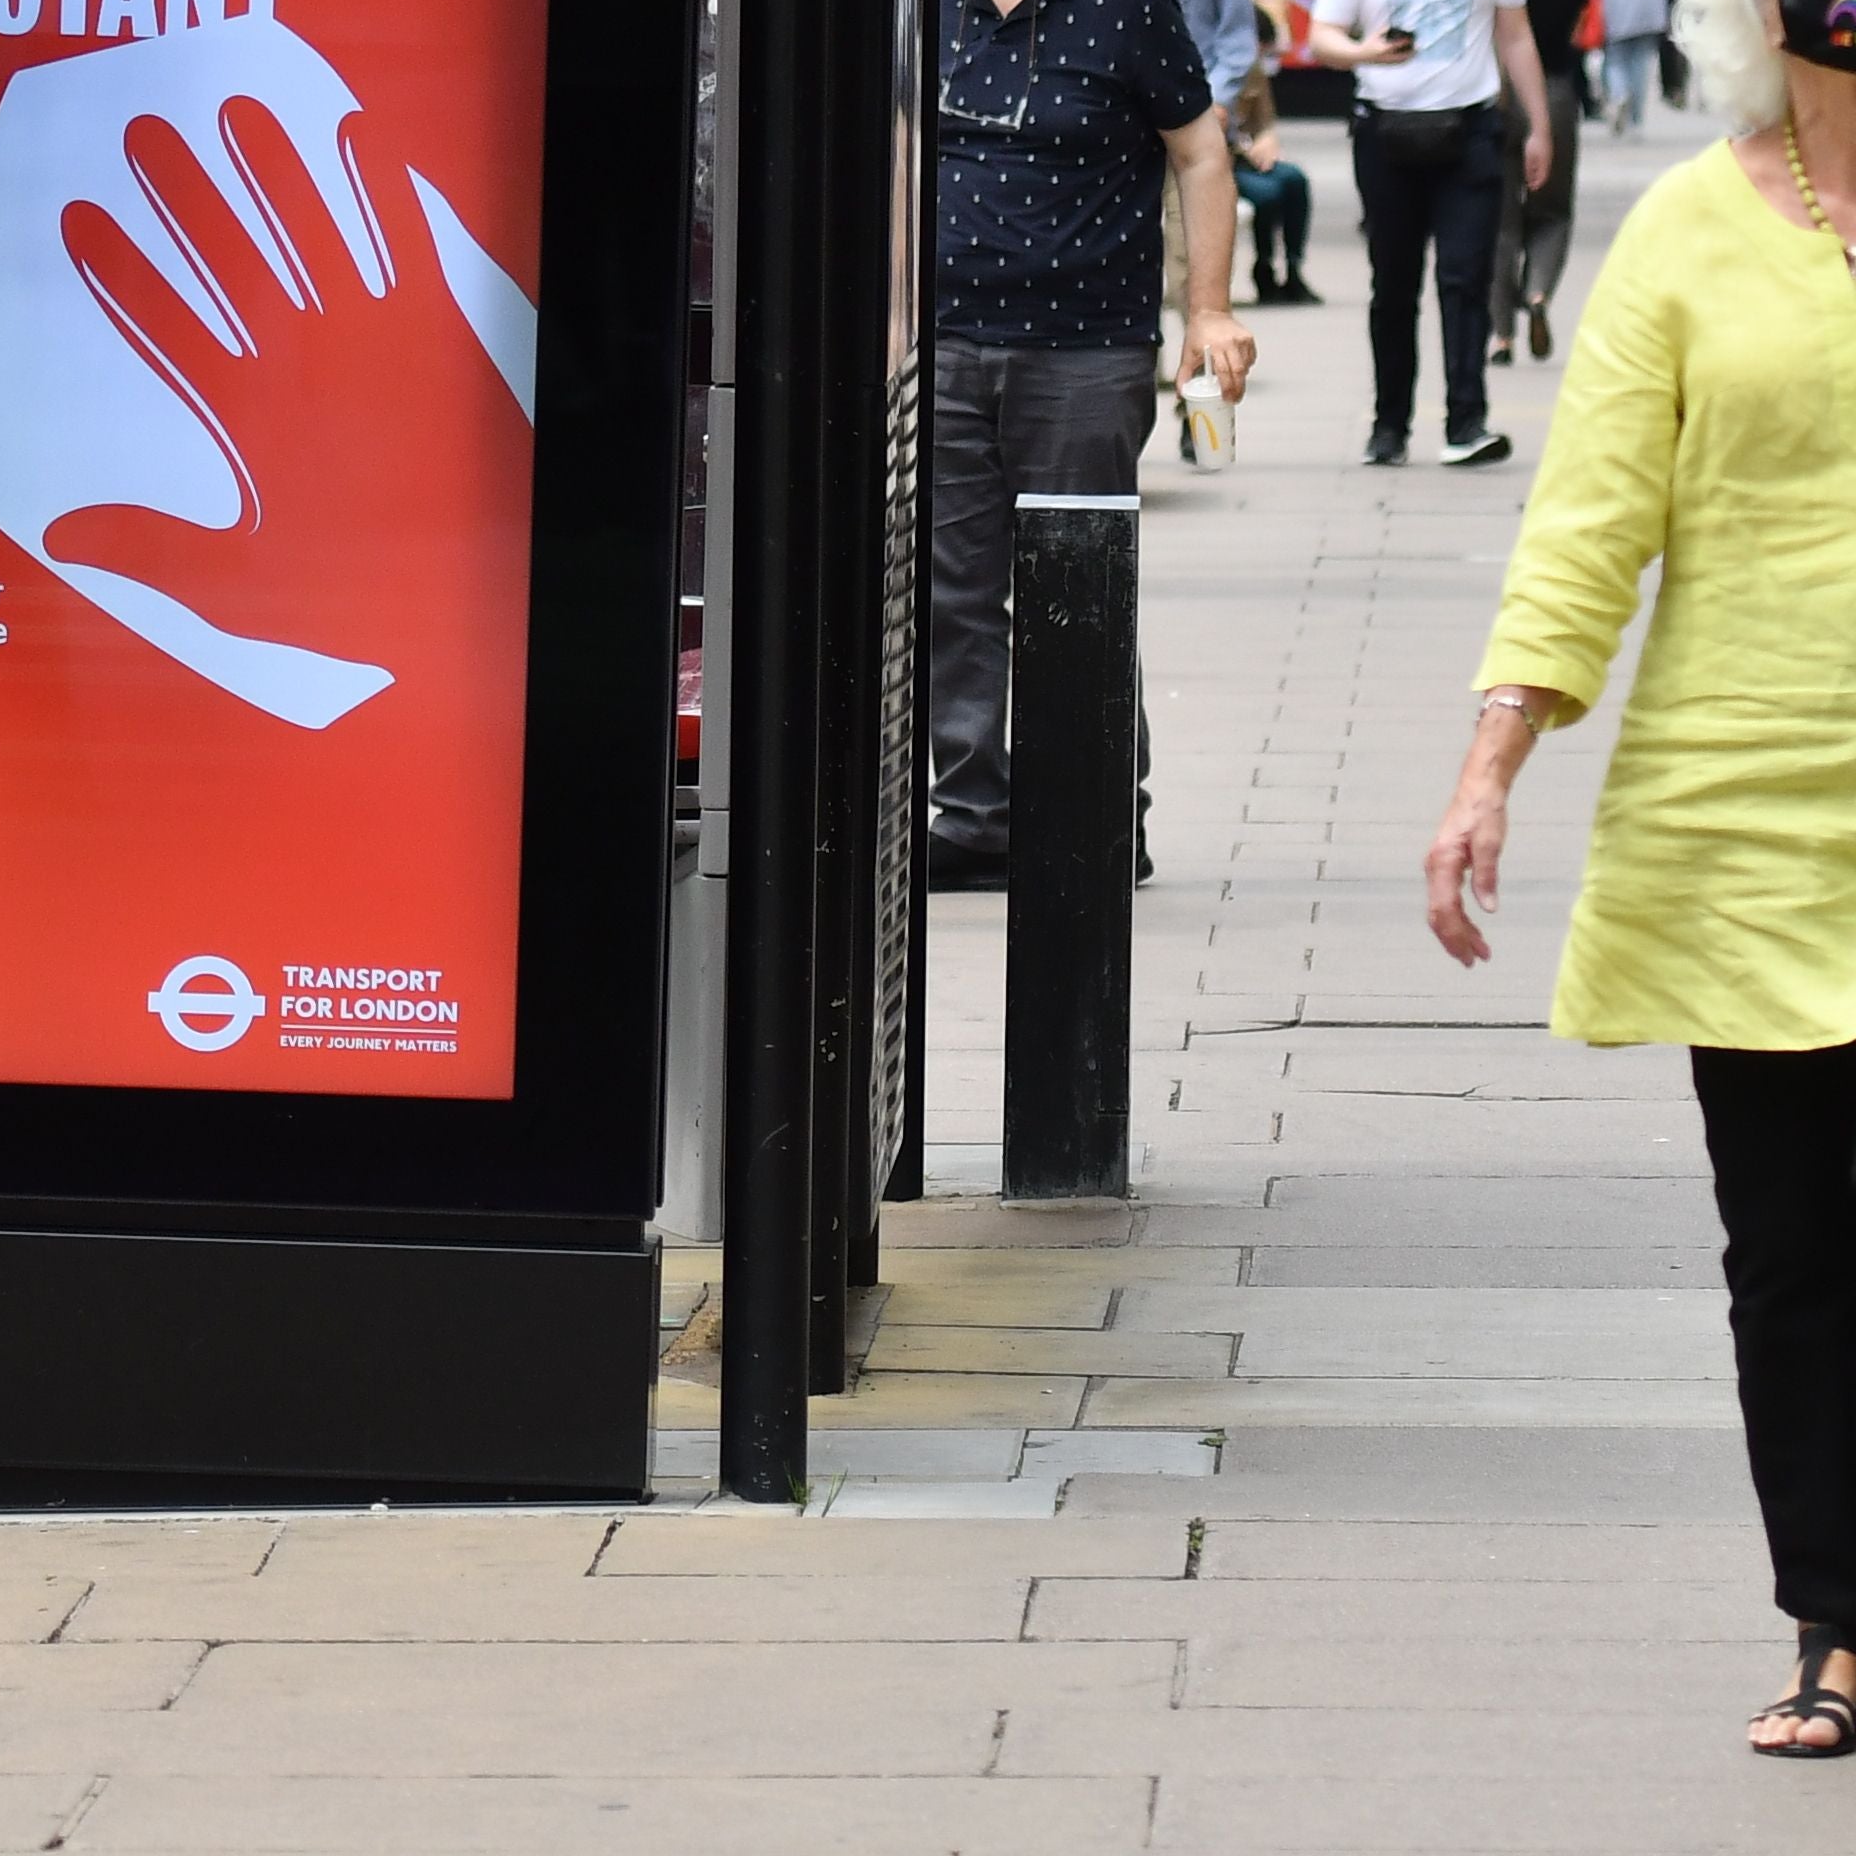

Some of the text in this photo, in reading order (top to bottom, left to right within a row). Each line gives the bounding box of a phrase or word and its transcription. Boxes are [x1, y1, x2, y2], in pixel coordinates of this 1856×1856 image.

[282, 965, 443, 992] TRANSPORT
[281, 995, 458, 1023] FOR LONDON
[279, 1034, 457, 1053] EVERY JOURNEY MATTERS
